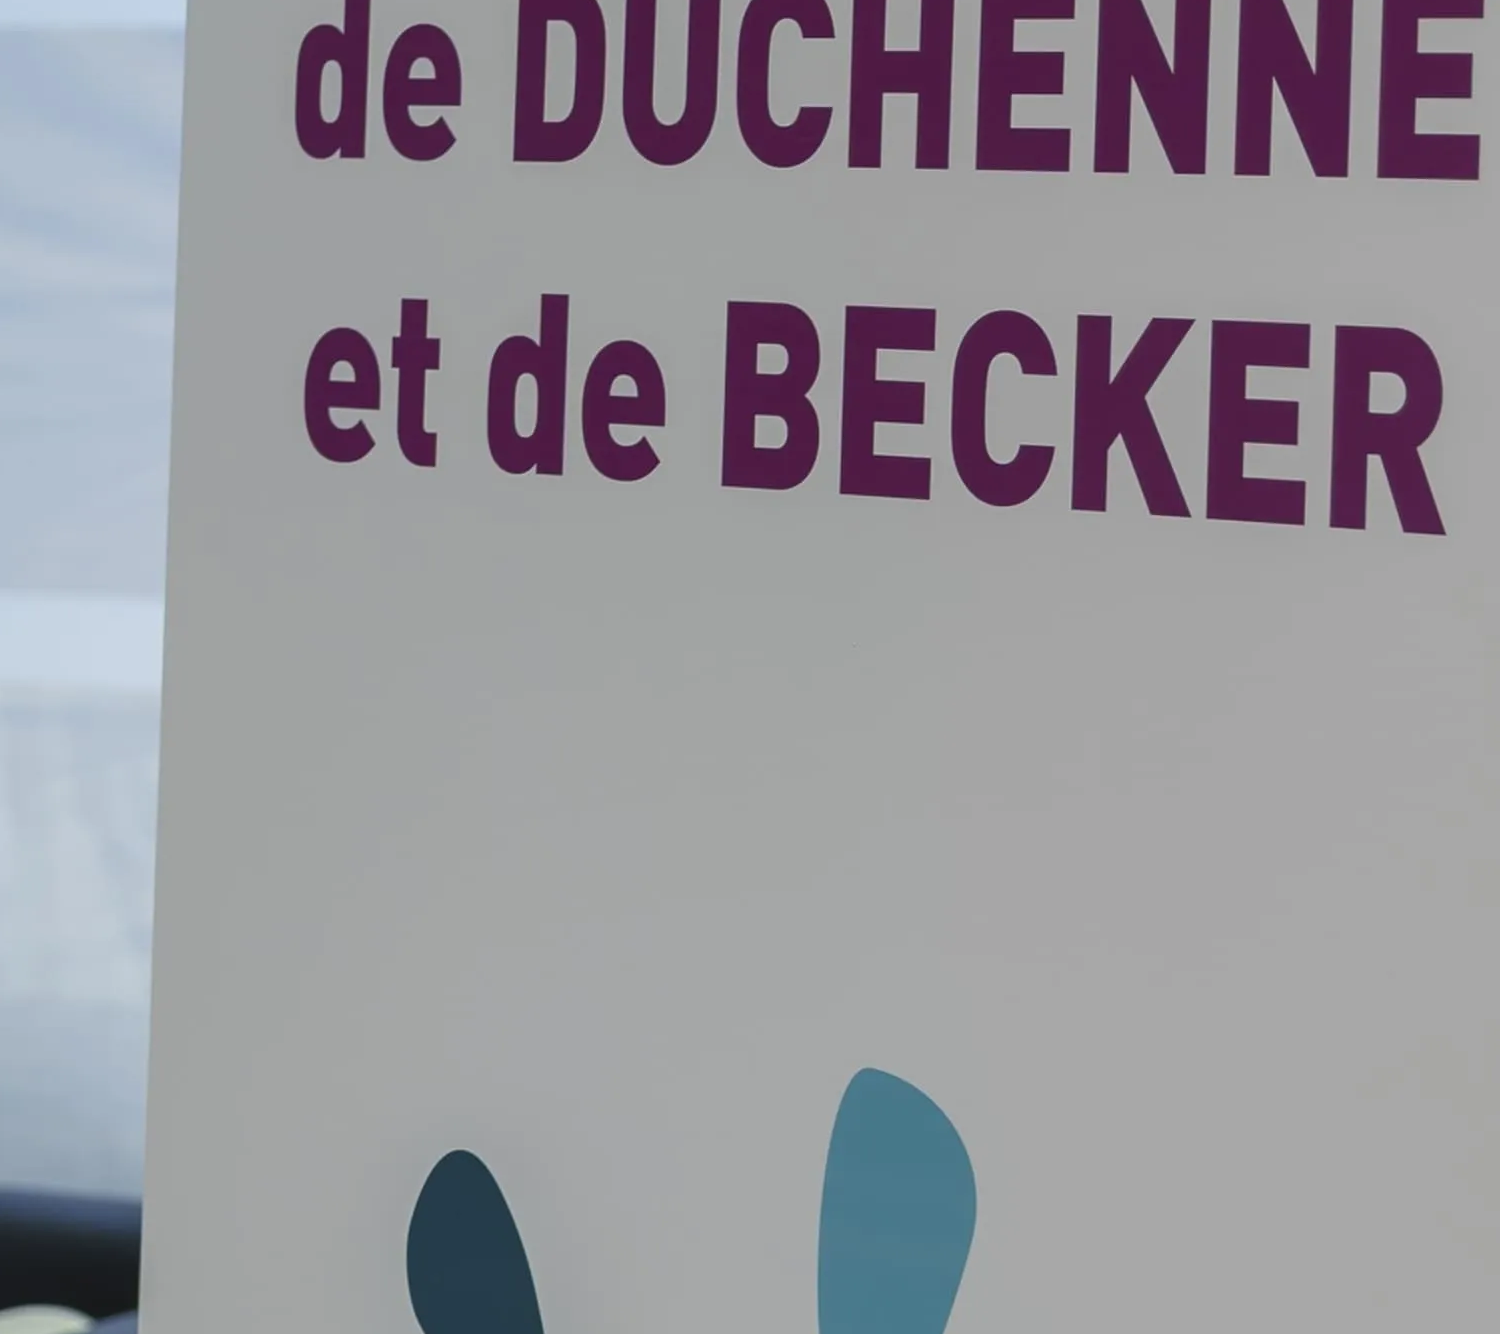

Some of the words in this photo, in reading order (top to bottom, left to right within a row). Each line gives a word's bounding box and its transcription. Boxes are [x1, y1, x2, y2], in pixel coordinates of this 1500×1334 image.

[304, 298, 440, 467] et
[486, 293, 666, 482] de
[720, 300, 1447, 535] BECKER
